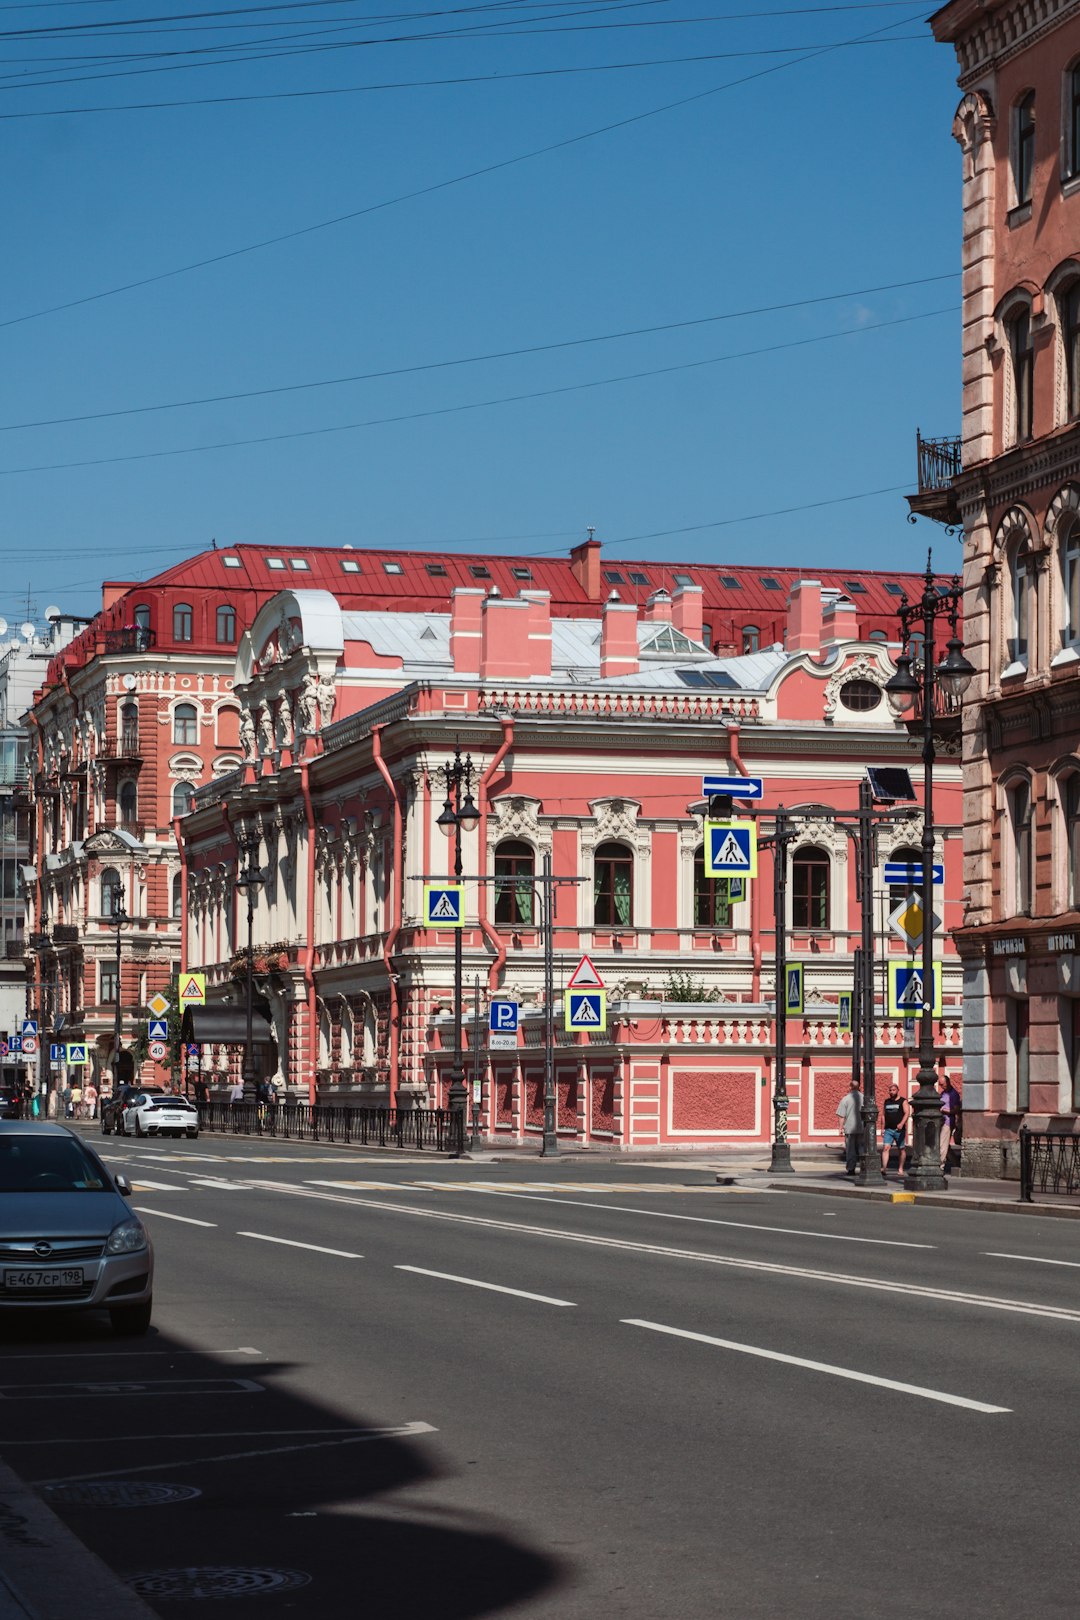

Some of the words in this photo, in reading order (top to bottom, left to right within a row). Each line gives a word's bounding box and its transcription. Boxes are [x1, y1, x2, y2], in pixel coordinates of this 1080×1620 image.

[992, 937, 1026, 955] КАРНИЗЫ
[1047, 934, 1076, 951] ШТОРЫ
[497, 1004, 513, 1028] P
[152, 1047, 164, 1055] 40
[62, 1271, 81, 1281] 198
